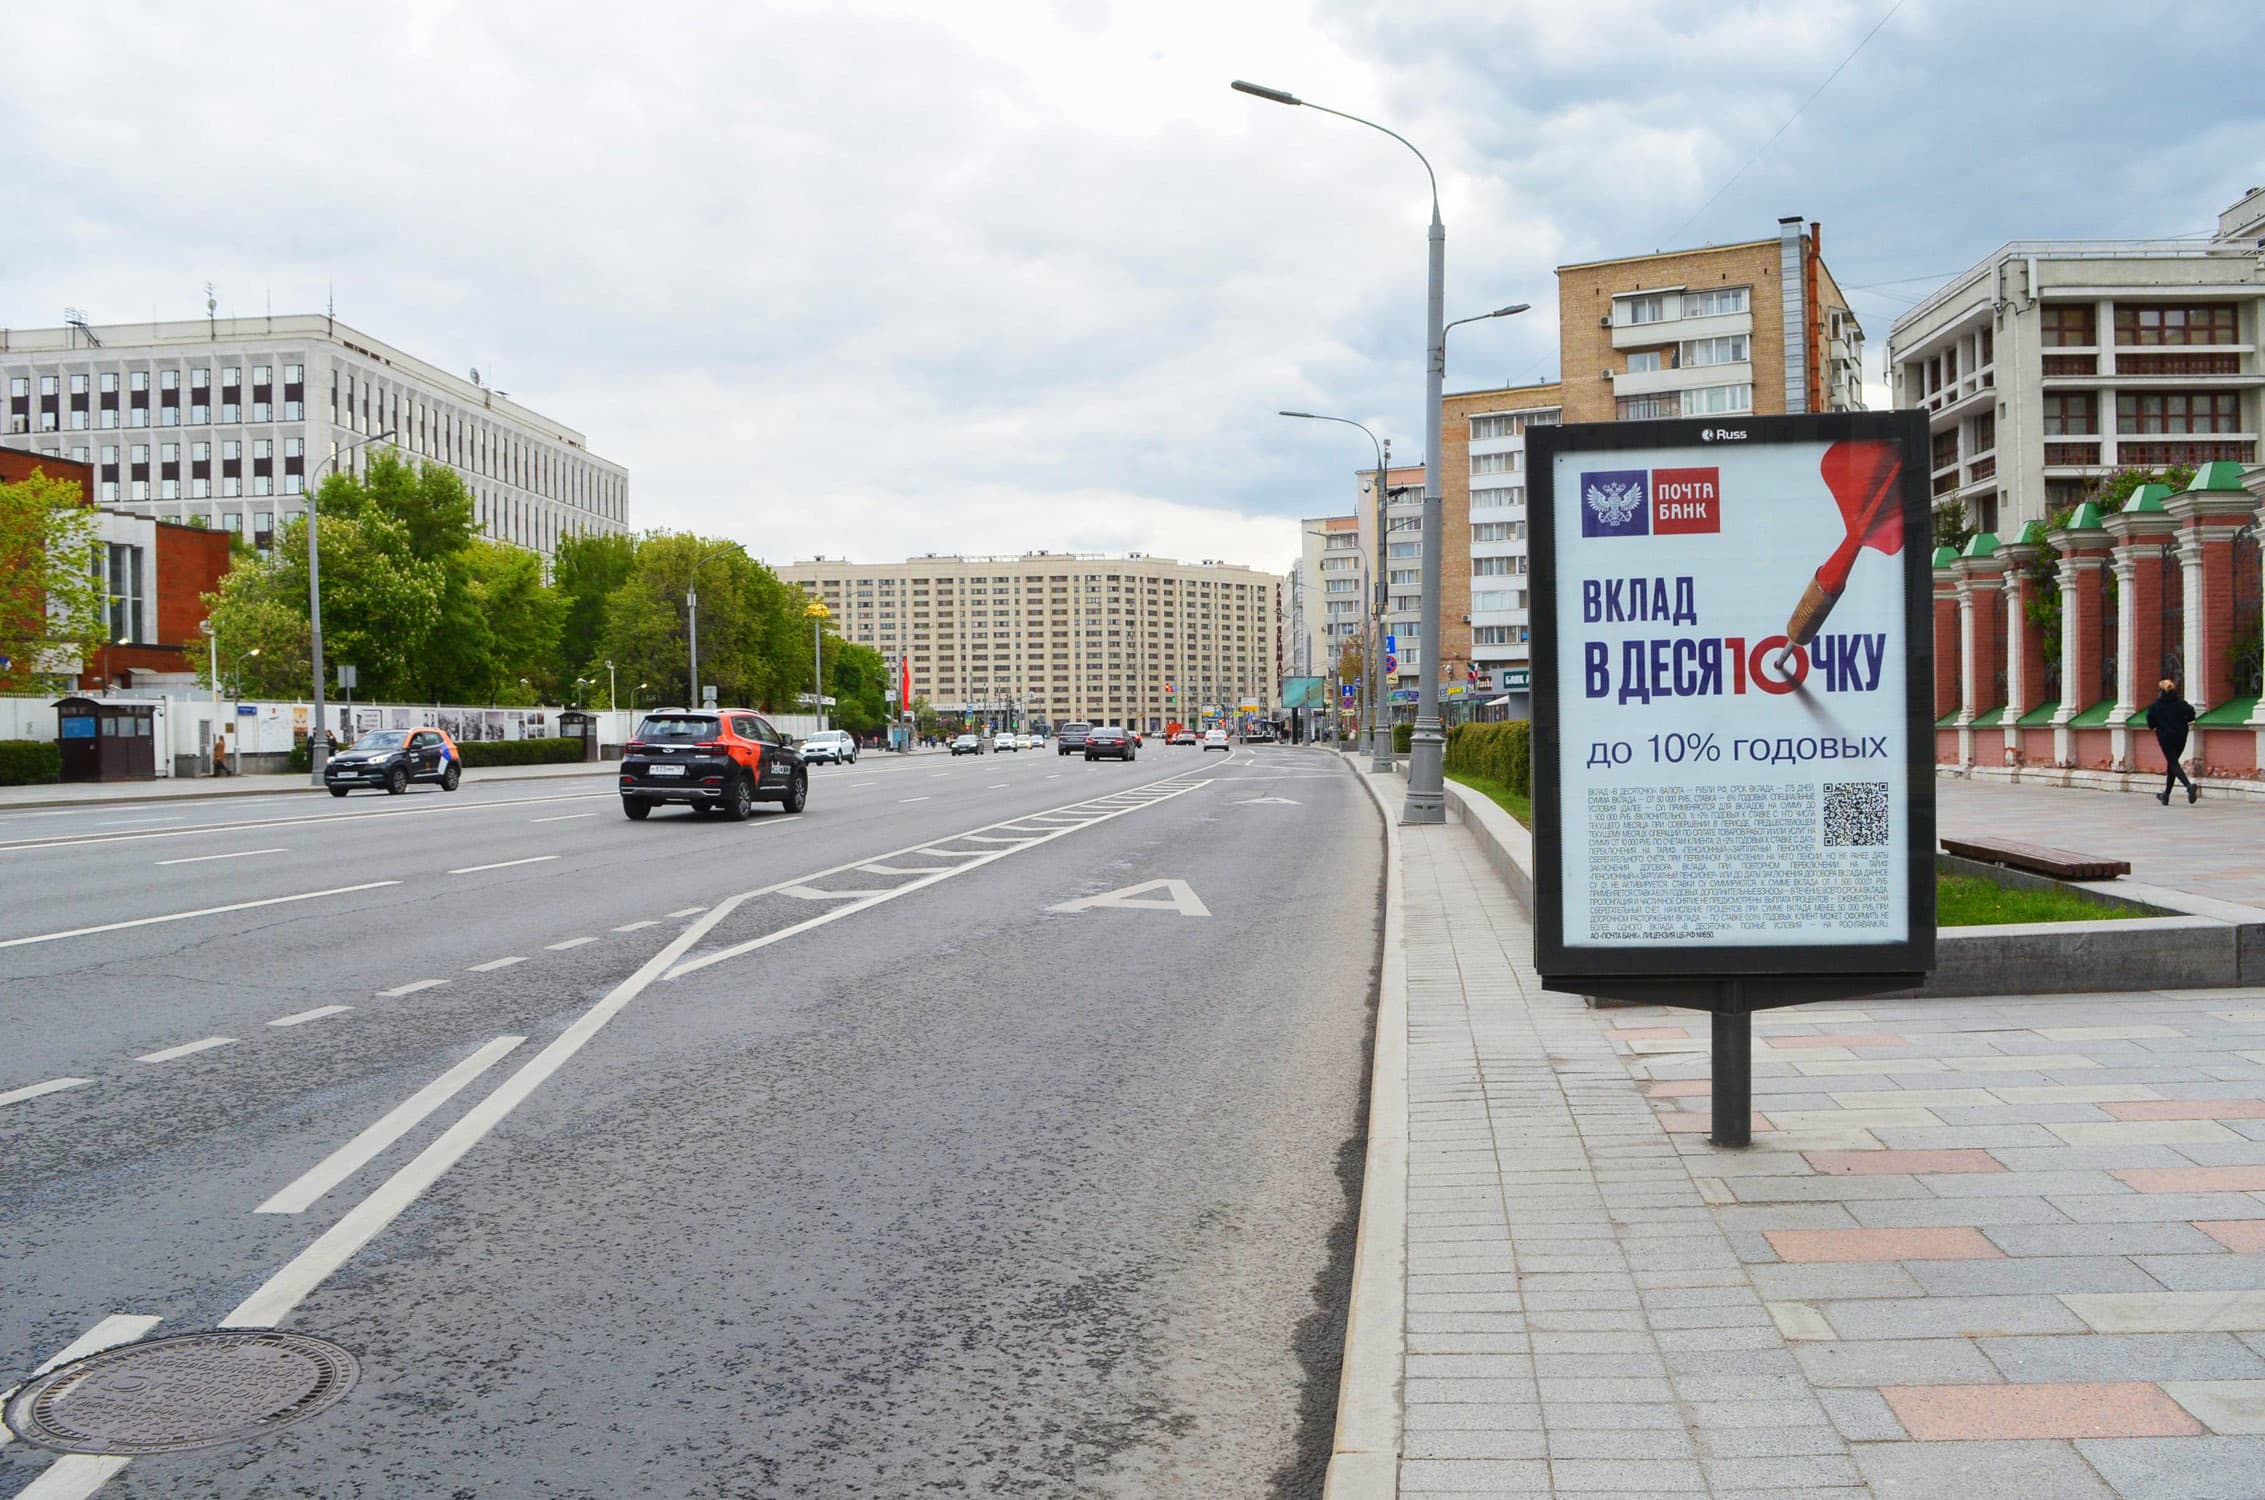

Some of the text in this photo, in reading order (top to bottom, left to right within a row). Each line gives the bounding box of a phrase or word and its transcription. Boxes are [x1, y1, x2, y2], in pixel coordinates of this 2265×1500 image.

[1716, 429, 1748, 440] Russ
[1658, 482, 1714, 500] ПОЧТА
[1659, 502, 1707, 520] БАНК
[1583, 576, 1697, 626] ВКЛАД
[1584, 641, 1610, 698] В
[1587, 732, 1888, 768] до 10% годовых
[1045, 878, 1212, 917] А
